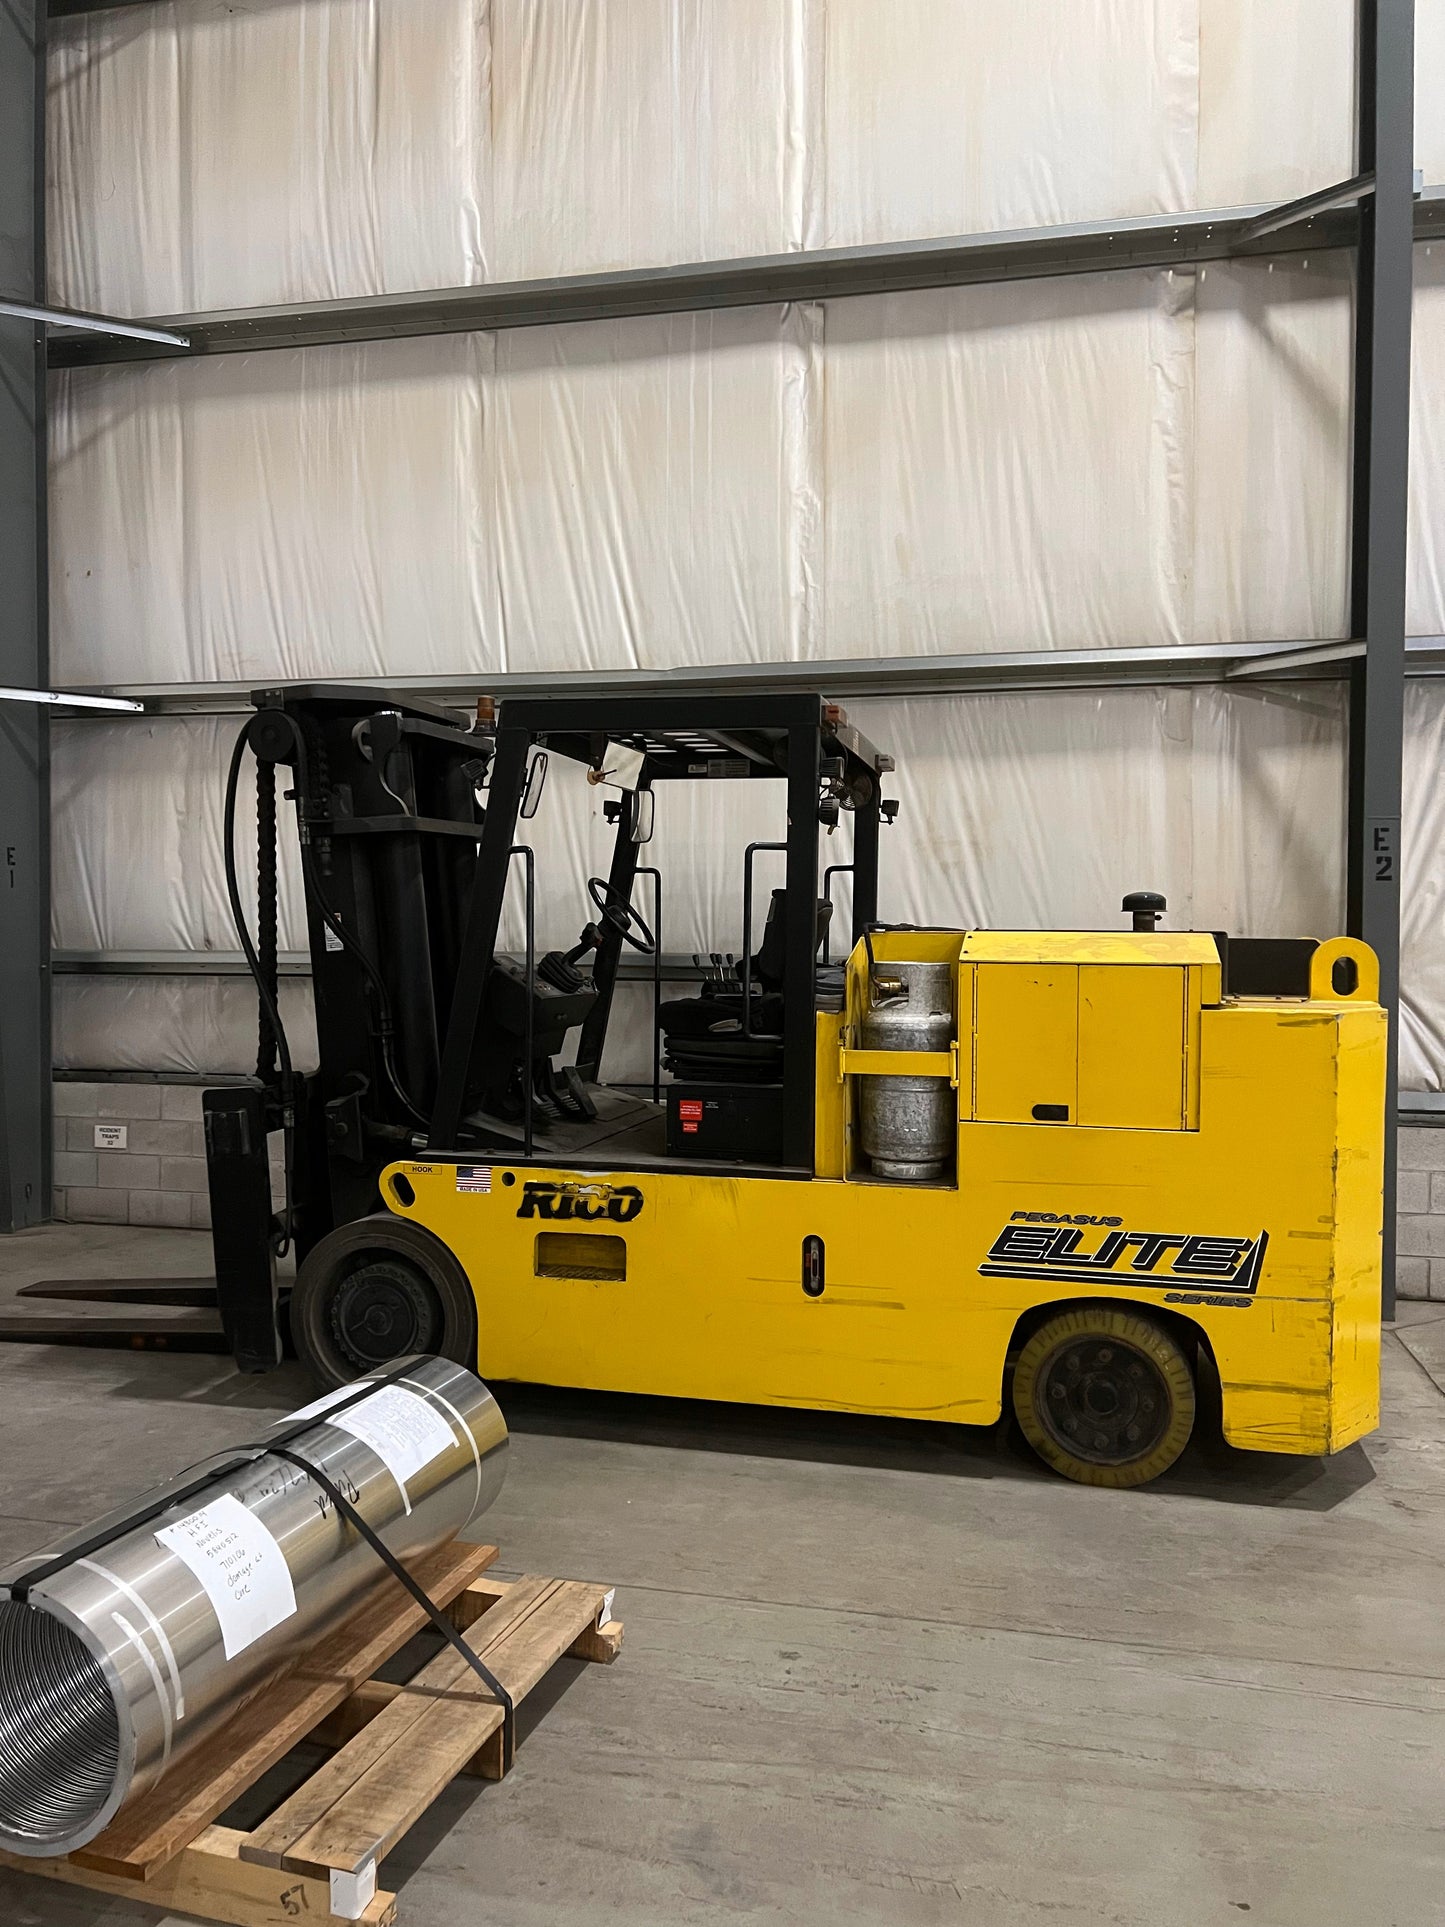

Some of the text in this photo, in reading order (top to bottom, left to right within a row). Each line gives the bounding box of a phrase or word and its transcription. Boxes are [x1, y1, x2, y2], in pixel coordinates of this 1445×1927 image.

[1010, 1211, 1124, 1227] PEGASUS
[986, 1224, 1254, 1277] ELITE
[1163, 1292, 1254, 1308] SERIES
[280, 1884, 309, 1915] 57
